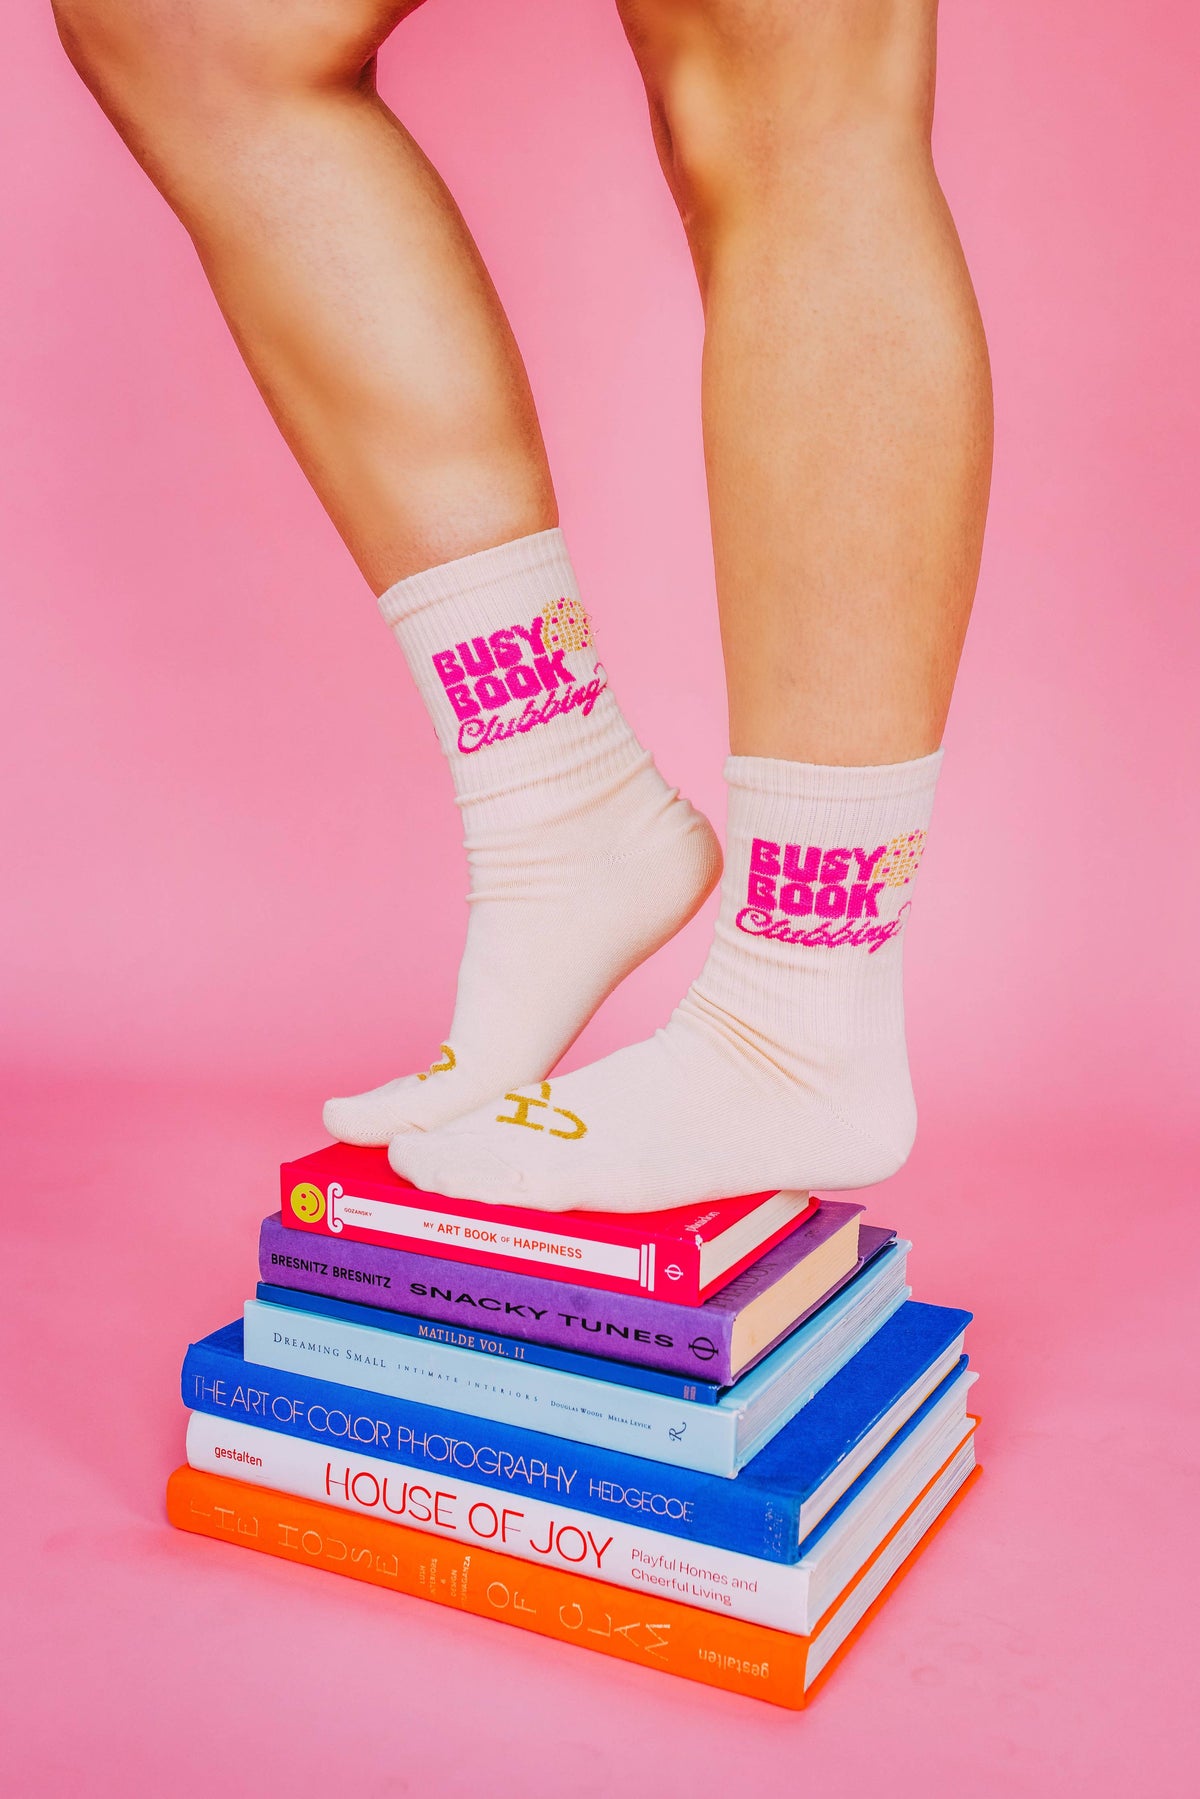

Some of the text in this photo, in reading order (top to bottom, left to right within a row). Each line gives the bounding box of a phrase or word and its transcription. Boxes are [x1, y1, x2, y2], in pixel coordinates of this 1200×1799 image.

[431, 616, 547, 688] BUSY
[445, 649, 577, 721] BOOK
[750, 838, 888, 884] BUSY
[747, 873, 886, 919] BOOK
[344, 1207, 373, 1217] GOZANSKY
[423, 1221, 434, 1229] MY
[437, 1223, 461, 1236] ART
[464, 1227, 498, 1244] BOOK
[513, 1237, 583, 1259] HAPPINESS
[270, 1253, 392, 1289] BRESNITZ BRESNITZ
[409, 1282, 674, 1349] SNACKY TUNES
[418, 1324, 525, 1360] MATILDE VOL. II
[397, 1363, 539, 1402] INTIMATE INTERIORS
[192, 1374, 695, 1523] THE ART OF COLOR PHOTOGRAPHY HEDGECOE
[214, 1446, 263, 1468] gestalten
[325, 1462, 614, 1569] HOUSE OF JOY
[277, 1522, 399, 1577] HOUSE
[486, 1581, 537, 1614] OF
[631, 1548, 758, 1593] Playful Homes and
[631, 1567, 732, 1607] Cheerful Living
[698, 1648, 769, 1679] gestalten
